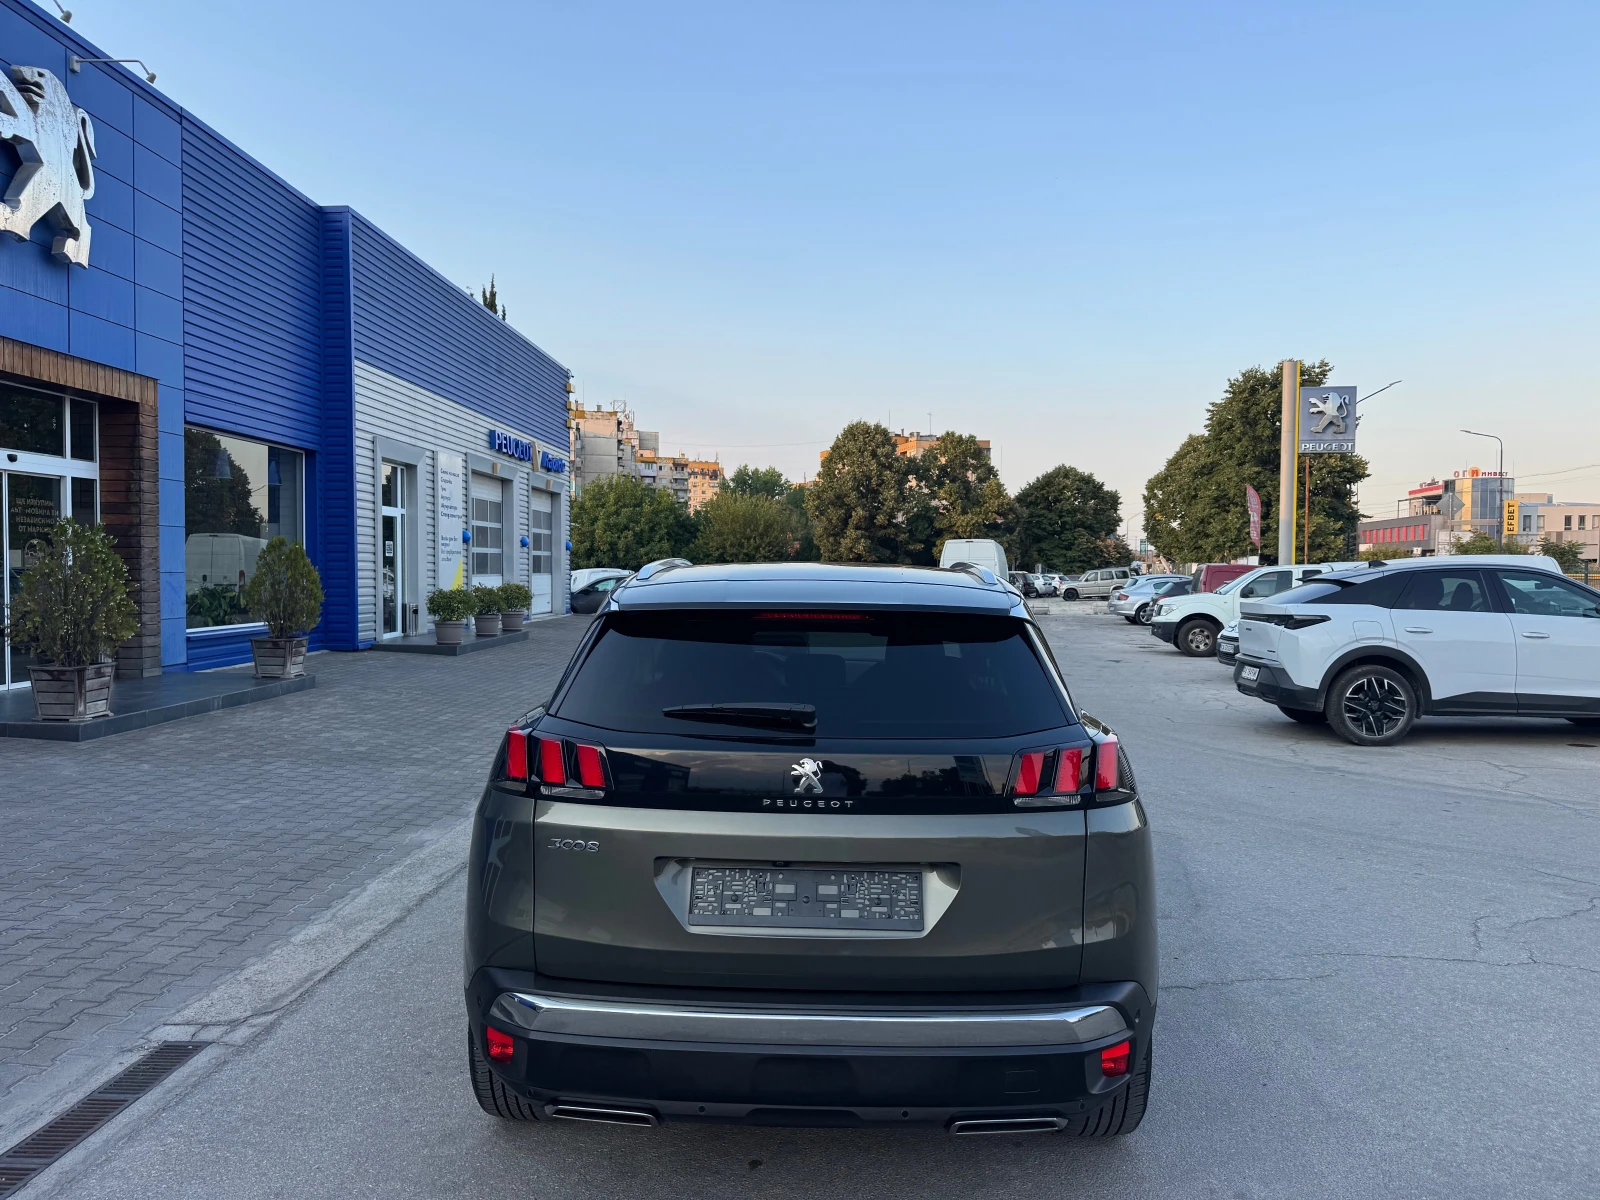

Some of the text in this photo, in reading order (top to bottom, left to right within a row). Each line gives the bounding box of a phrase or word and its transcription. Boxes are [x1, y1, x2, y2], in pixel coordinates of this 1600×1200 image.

[491, 430, 533, 462] PEUGEOT
[1301, 442, 1355, 451] PEUGEOT
[10, 506, 51, 516] АВТМОБИЛА
[1507, 502, 1515, 532] EFBET
[18, 525, 27, 533] ОТ
[762, 798, 854, 808] PEUGEOT
[547, 838, 600, 853] 3008
